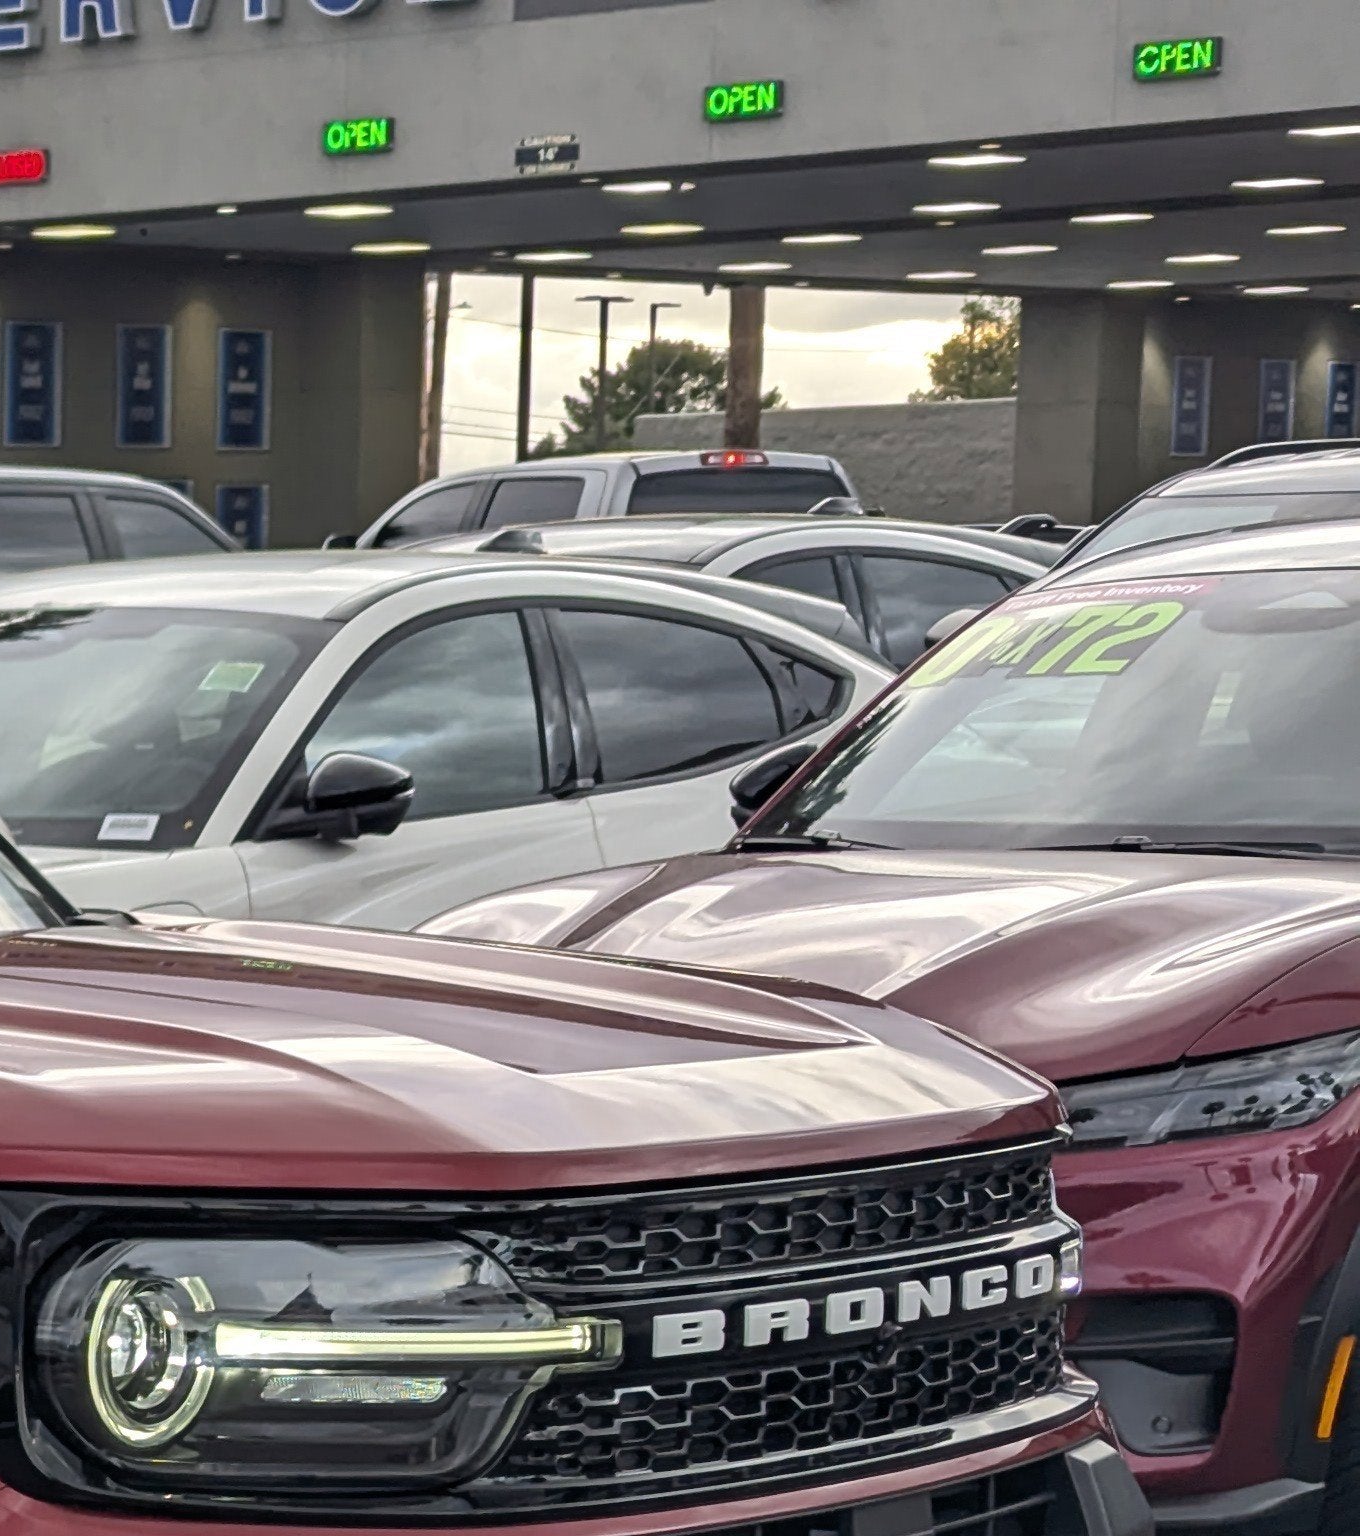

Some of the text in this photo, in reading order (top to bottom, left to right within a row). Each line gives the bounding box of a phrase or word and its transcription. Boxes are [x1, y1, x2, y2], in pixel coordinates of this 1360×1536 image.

[1138, 39, 1214, 73] OPEN
[709, 82, 775, 114] OPEN
[326, 118, 387, 149] OPEN
[1056, 590, 1100, 605] Free
[1103, 582, 1206, 598] Inventory
[651, 1253, 1055, 1359] BRONCO
